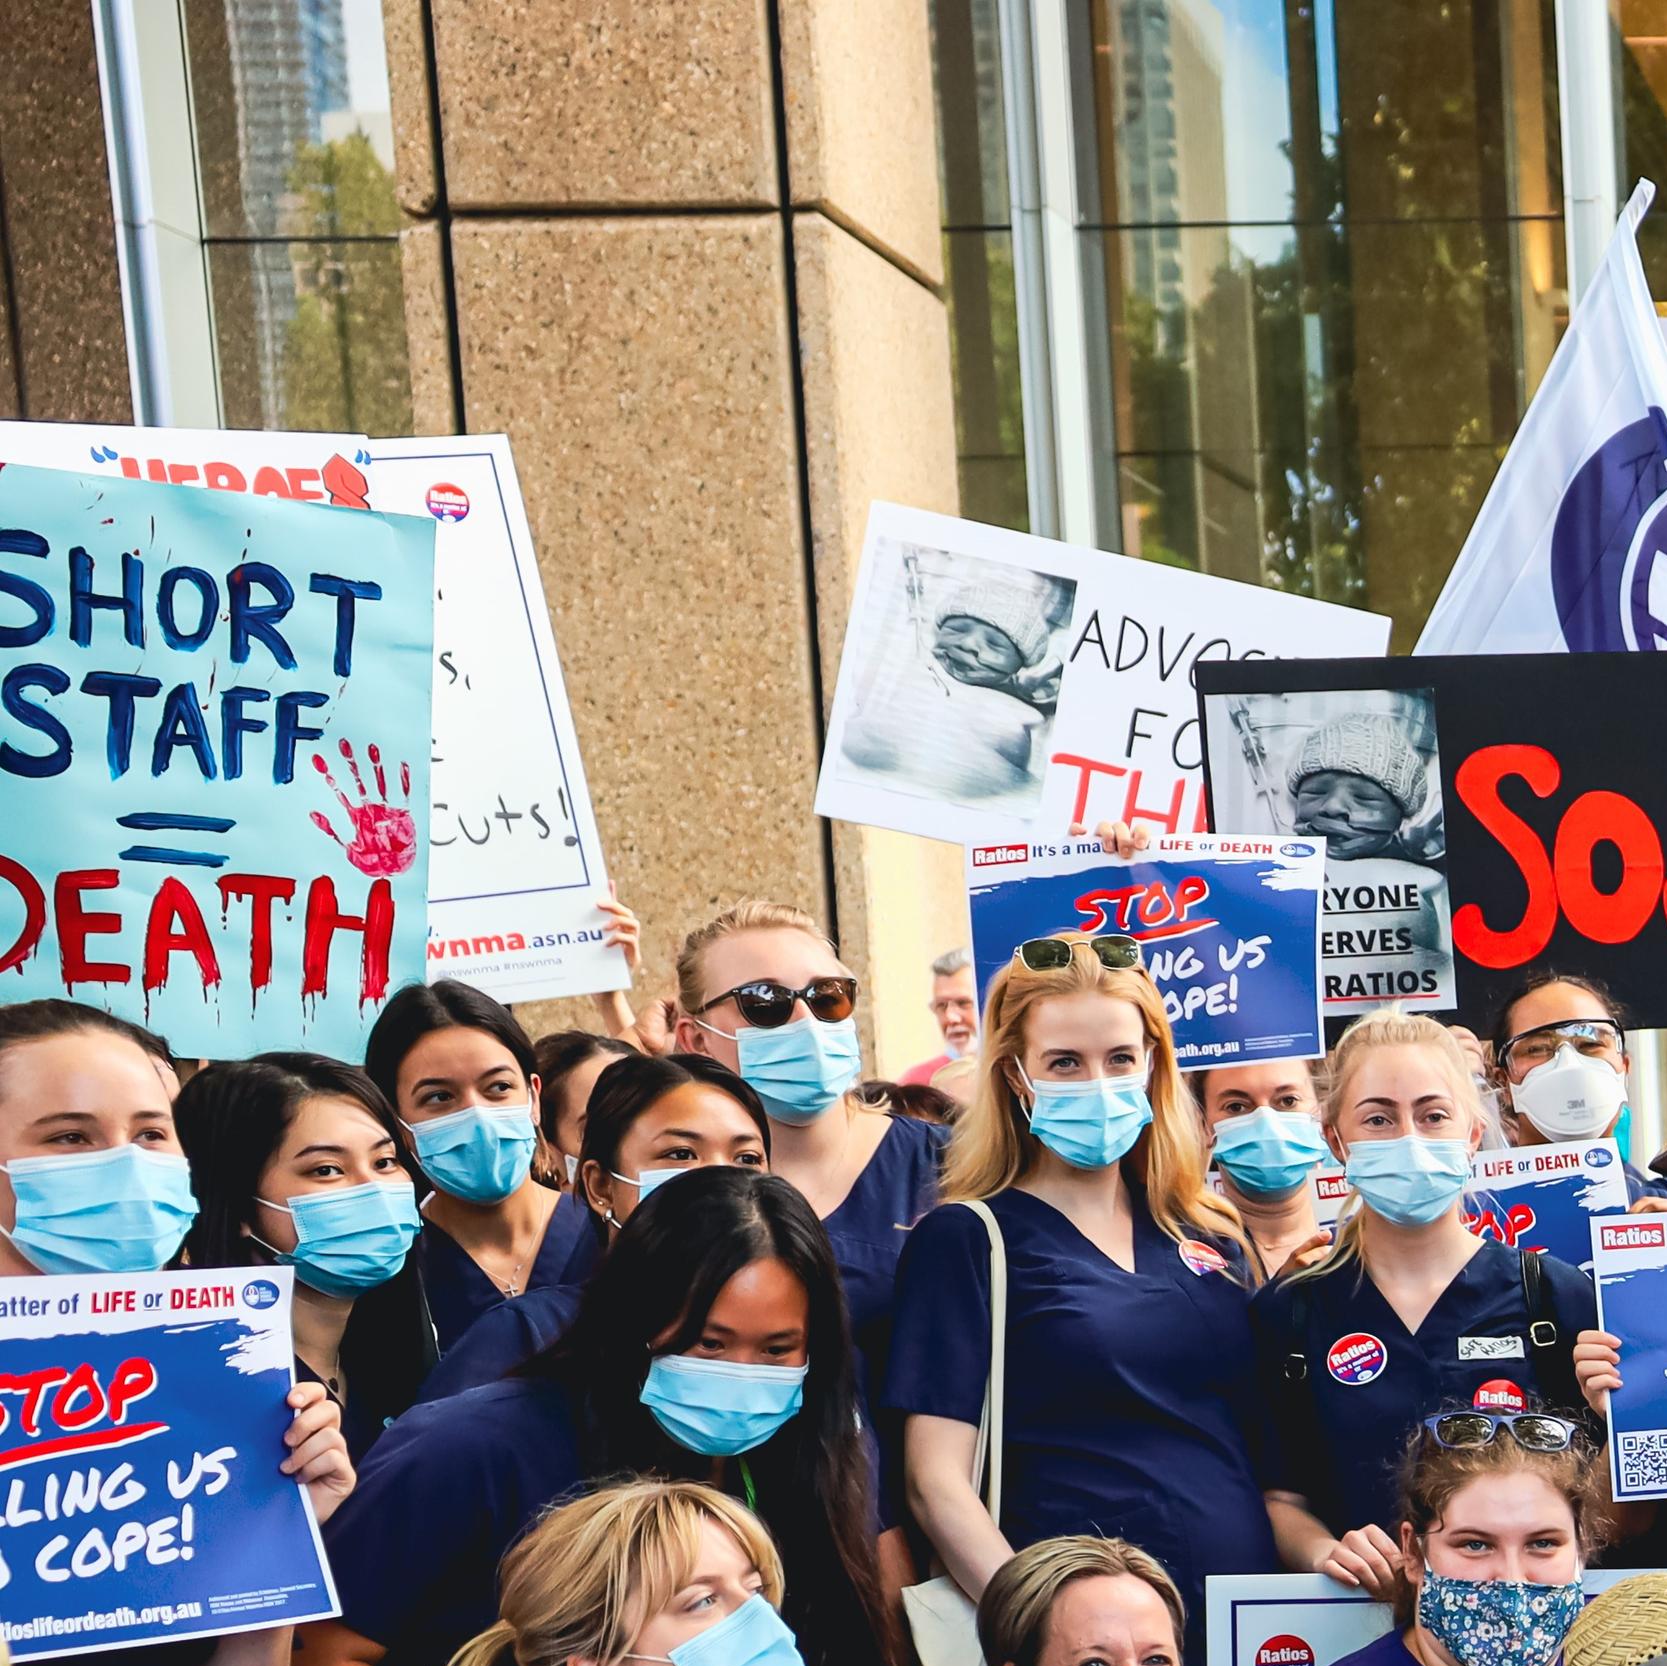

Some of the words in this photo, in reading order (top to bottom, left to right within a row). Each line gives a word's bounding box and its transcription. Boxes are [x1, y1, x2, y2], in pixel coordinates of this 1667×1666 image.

[0, 664, 330, 784] STAFF
[1325, 970, 1438, 996] RATIOS
[1602, 1227, 1662, 1246] Ratios
[1331, 1340, 1376, 1366] Ratios
